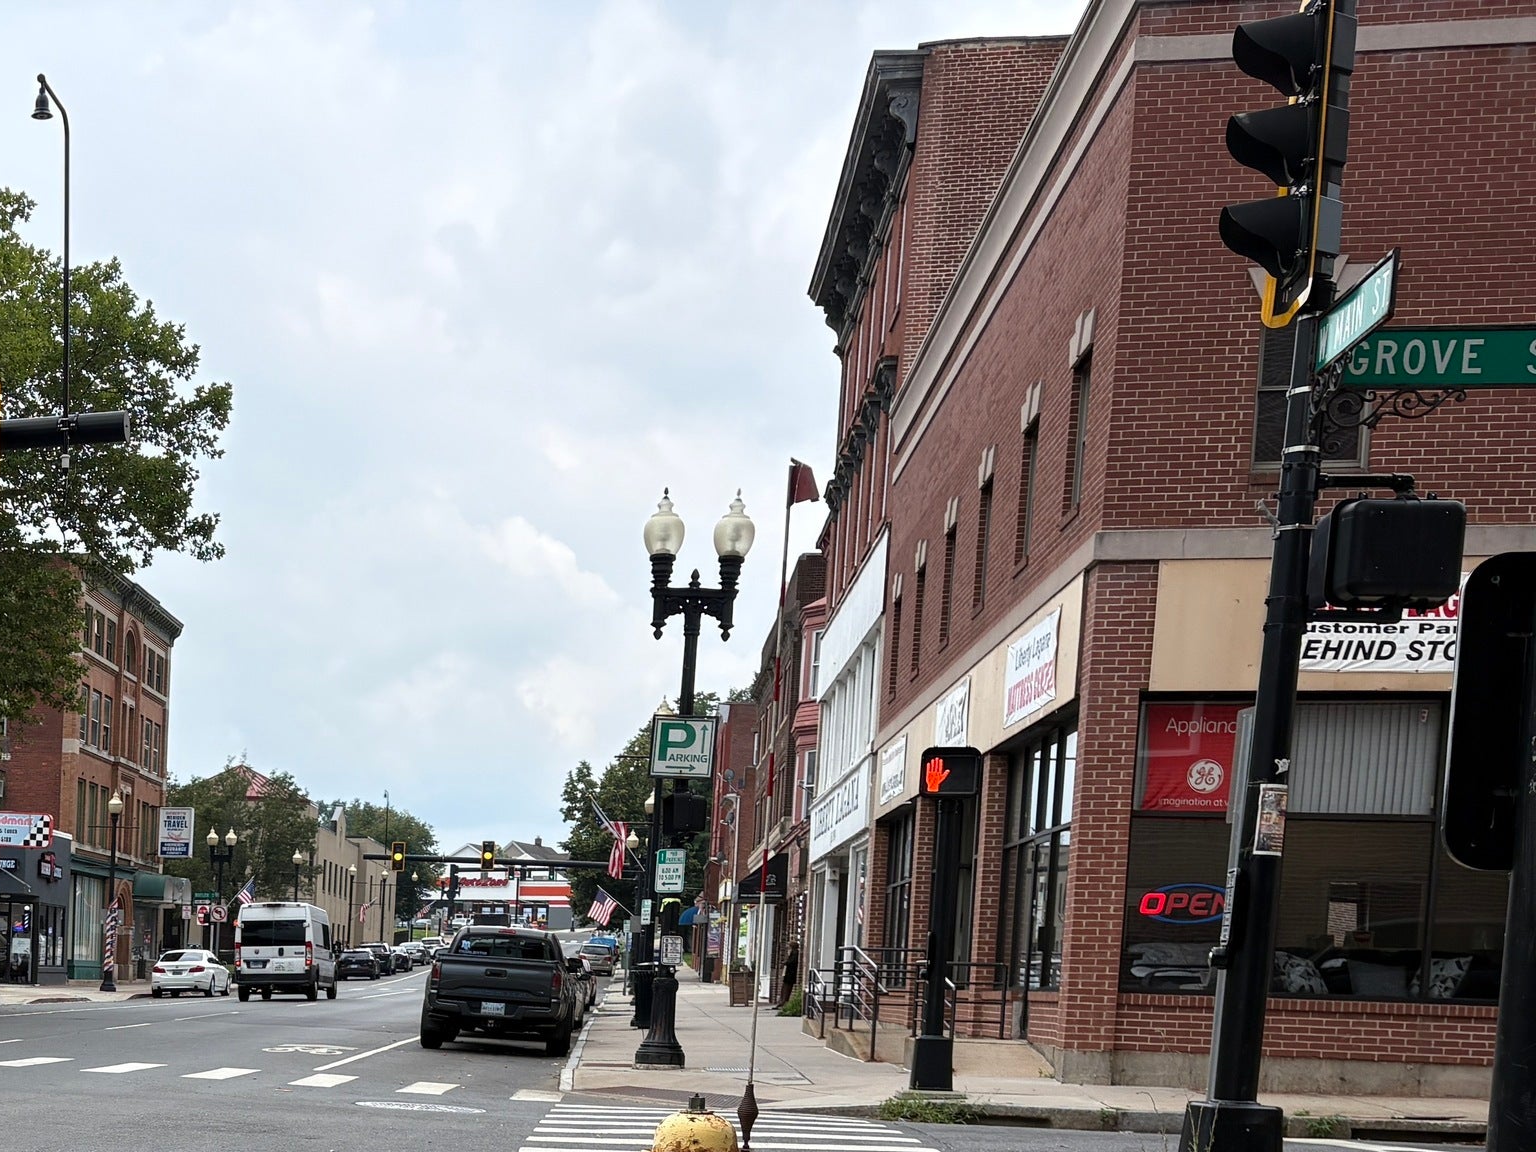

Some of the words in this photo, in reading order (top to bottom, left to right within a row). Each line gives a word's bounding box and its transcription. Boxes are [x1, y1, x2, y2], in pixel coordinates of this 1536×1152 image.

[1334, 292, 1364, 350] MAIN
[1348, 339, 1485, 376] GROVE
[1306, 623, 1409, 634] ustomer
[1302, 640, 1396, 660] EHIND
[1406, 641, 1456, 661] STO
[1165, 717, 1238, 736] Applianc
[658, 722, 708, 763] PARKING
[1213, 799, 1223, 807] at
[164, 820, 188, 828] TRAVEL
[1139, 892, 1227, 916] OPEN
